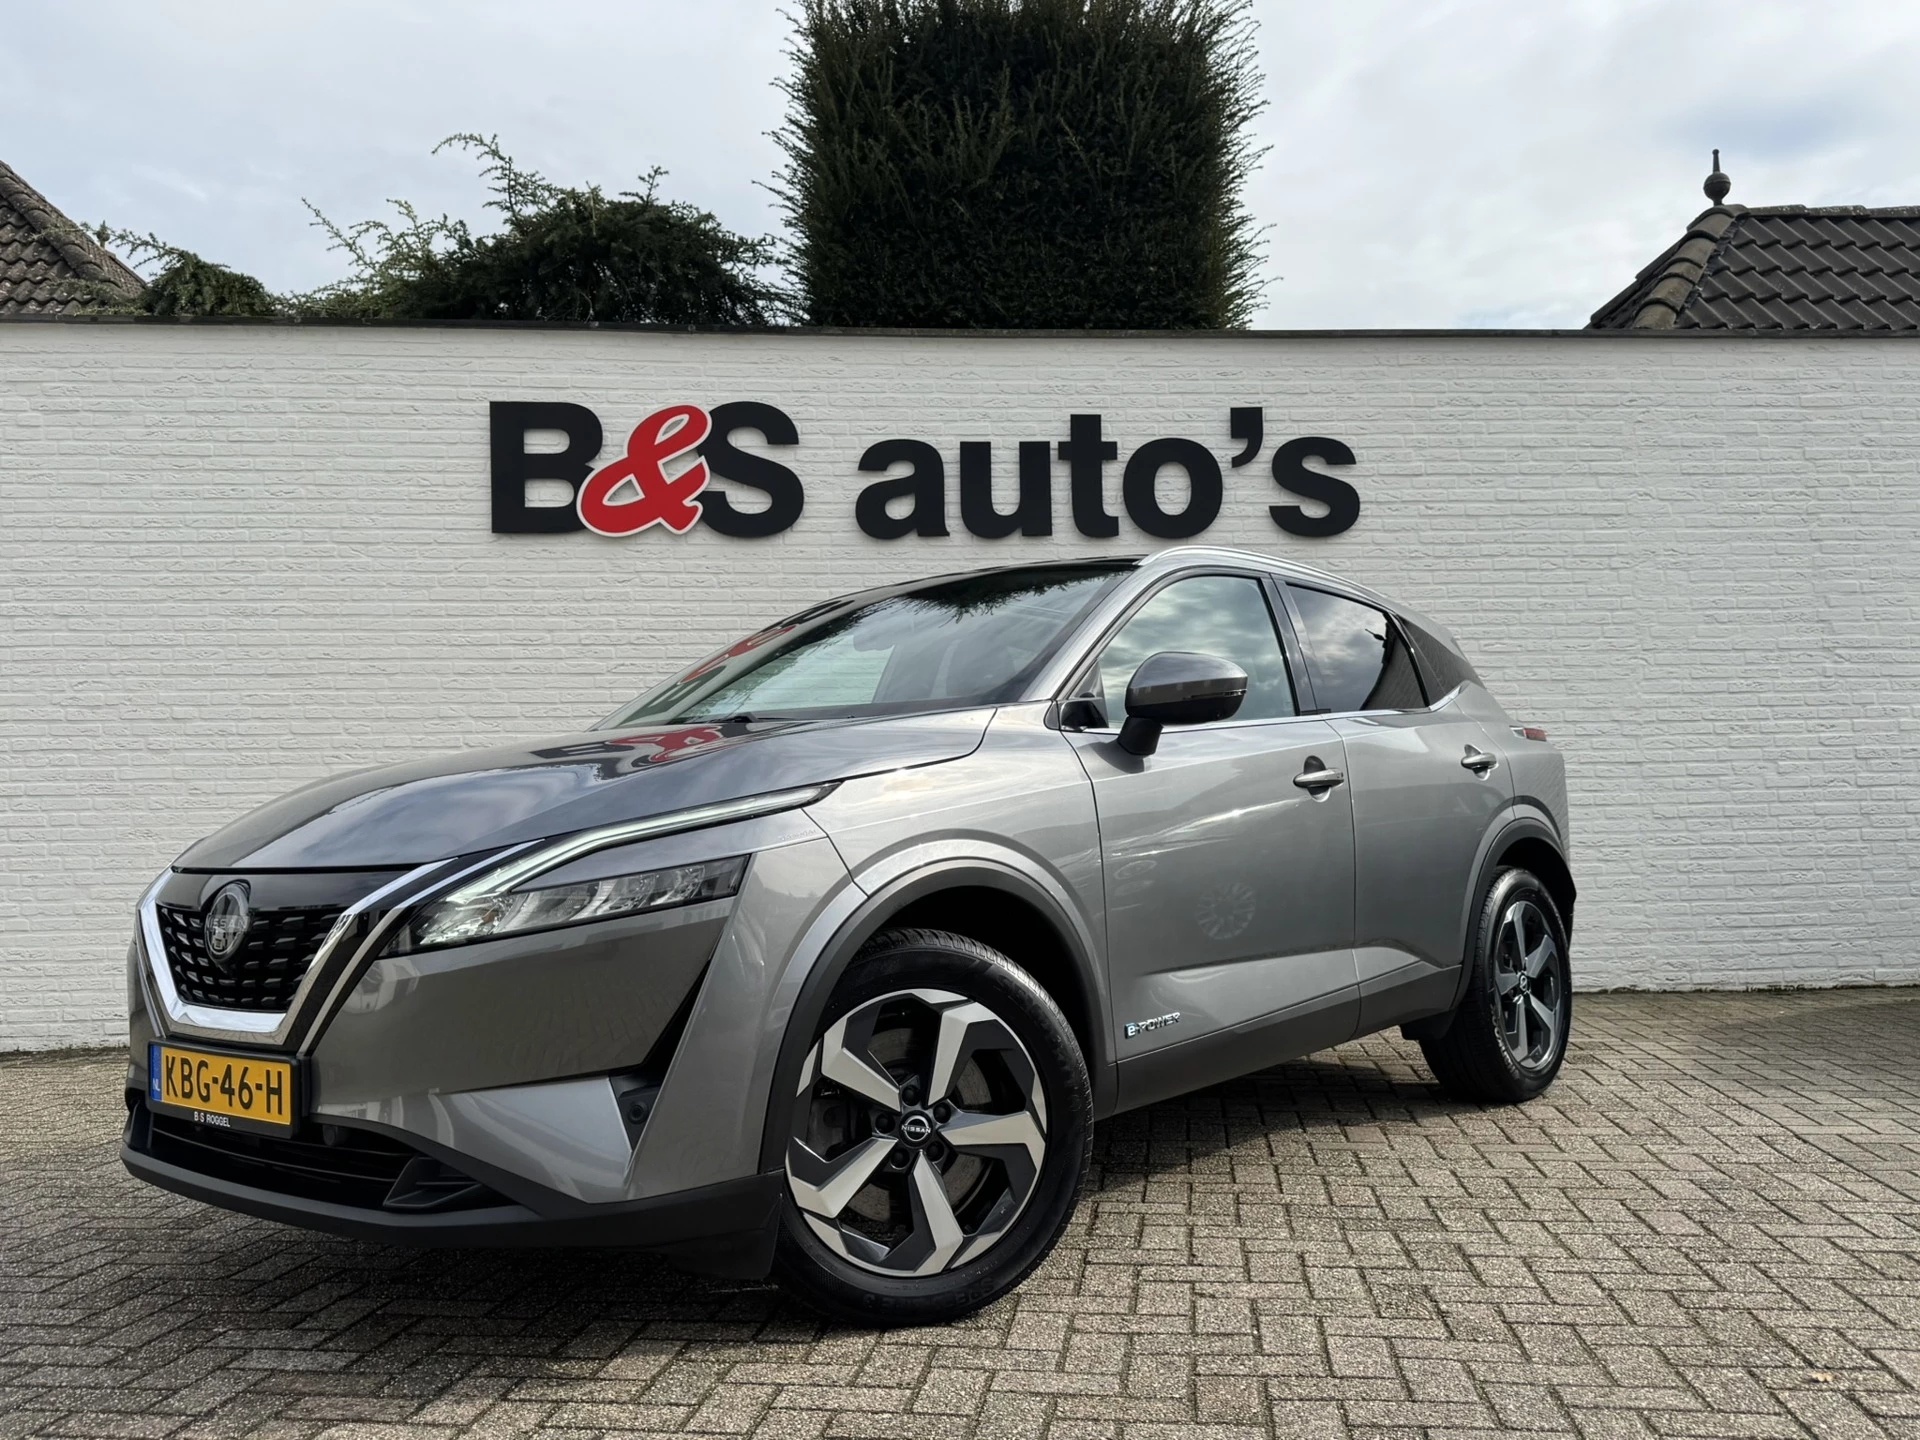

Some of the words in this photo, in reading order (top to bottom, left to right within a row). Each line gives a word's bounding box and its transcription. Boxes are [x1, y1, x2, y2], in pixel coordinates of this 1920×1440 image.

[490, 401, 804, 538] B&S
[855, 407, 1361, 539] auto's
[152, 1078, 161, 1091] NL
[166, 1055, 282, 1115] KBG-46-H
[194, 1111, 199, 1121] B
[200, 1112, 205, 1123] S
[206, 1114, 230, 1127] ROGGEL
[901, 1125, 931, 1134] NISSAN
